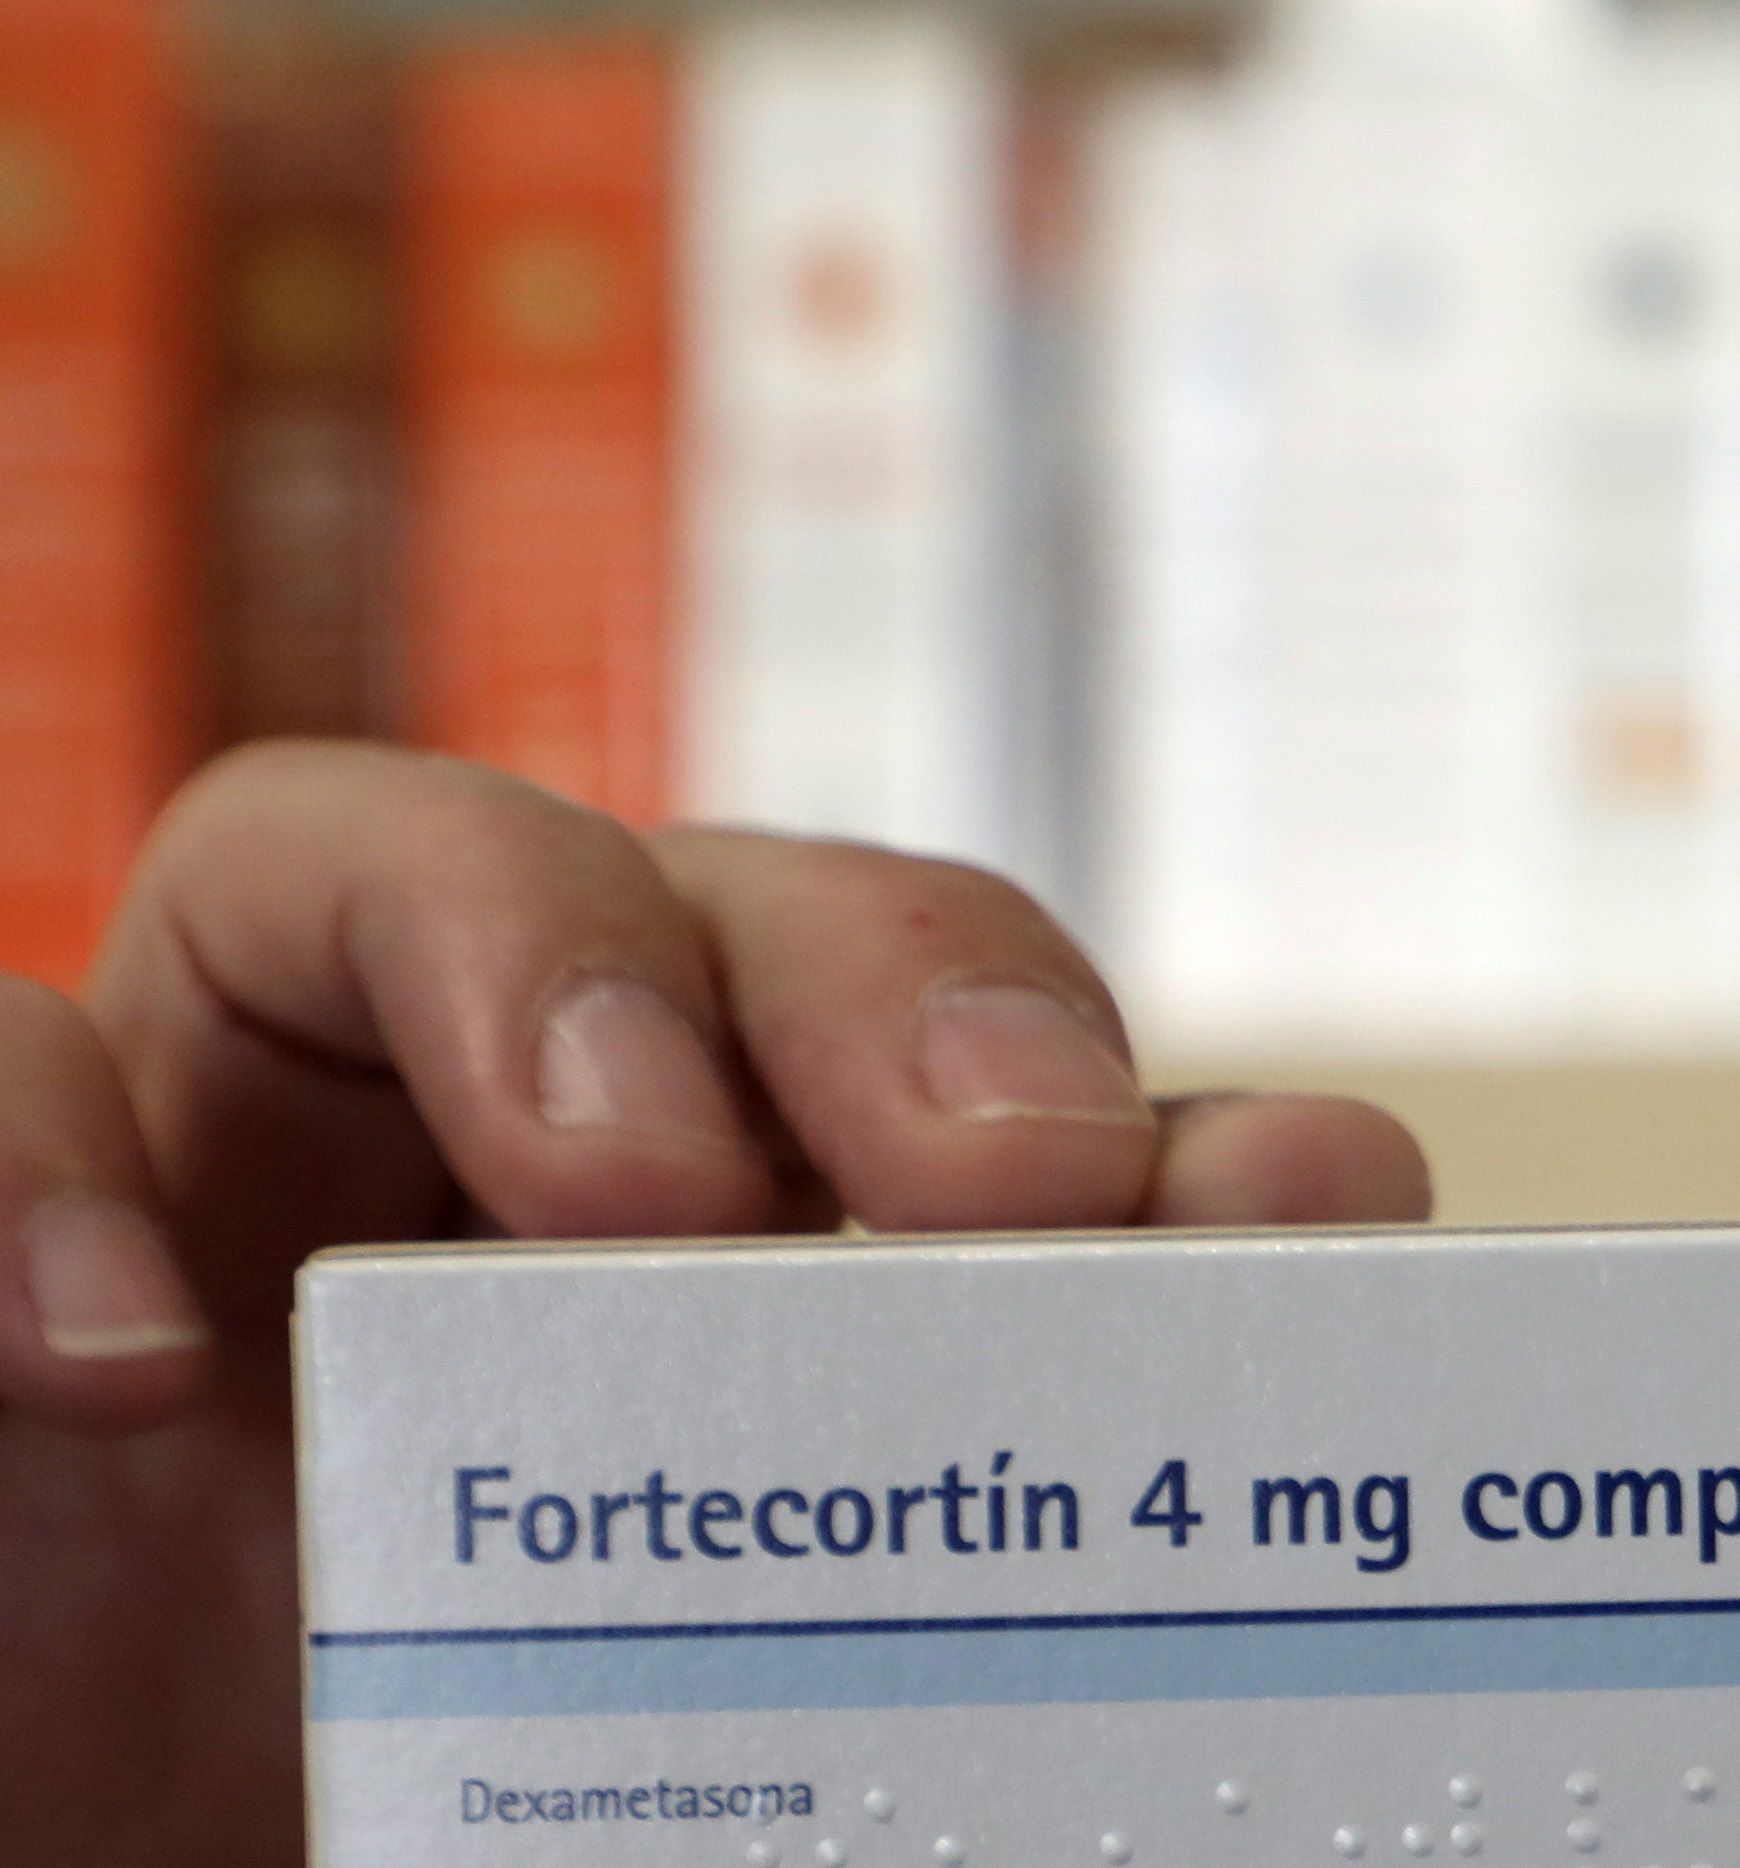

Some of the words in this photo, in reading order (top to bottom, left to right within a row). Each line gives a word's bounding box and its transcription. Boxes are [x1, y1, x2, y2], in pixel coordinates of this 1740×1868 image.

[457, 1451, 1079, 1563] Fortecortín
[1131, 1459, 1203, 1548] 4
[1253, 1475, 1411, 1573] mg
[464, 1780, 814, 1823] Dexametasona
